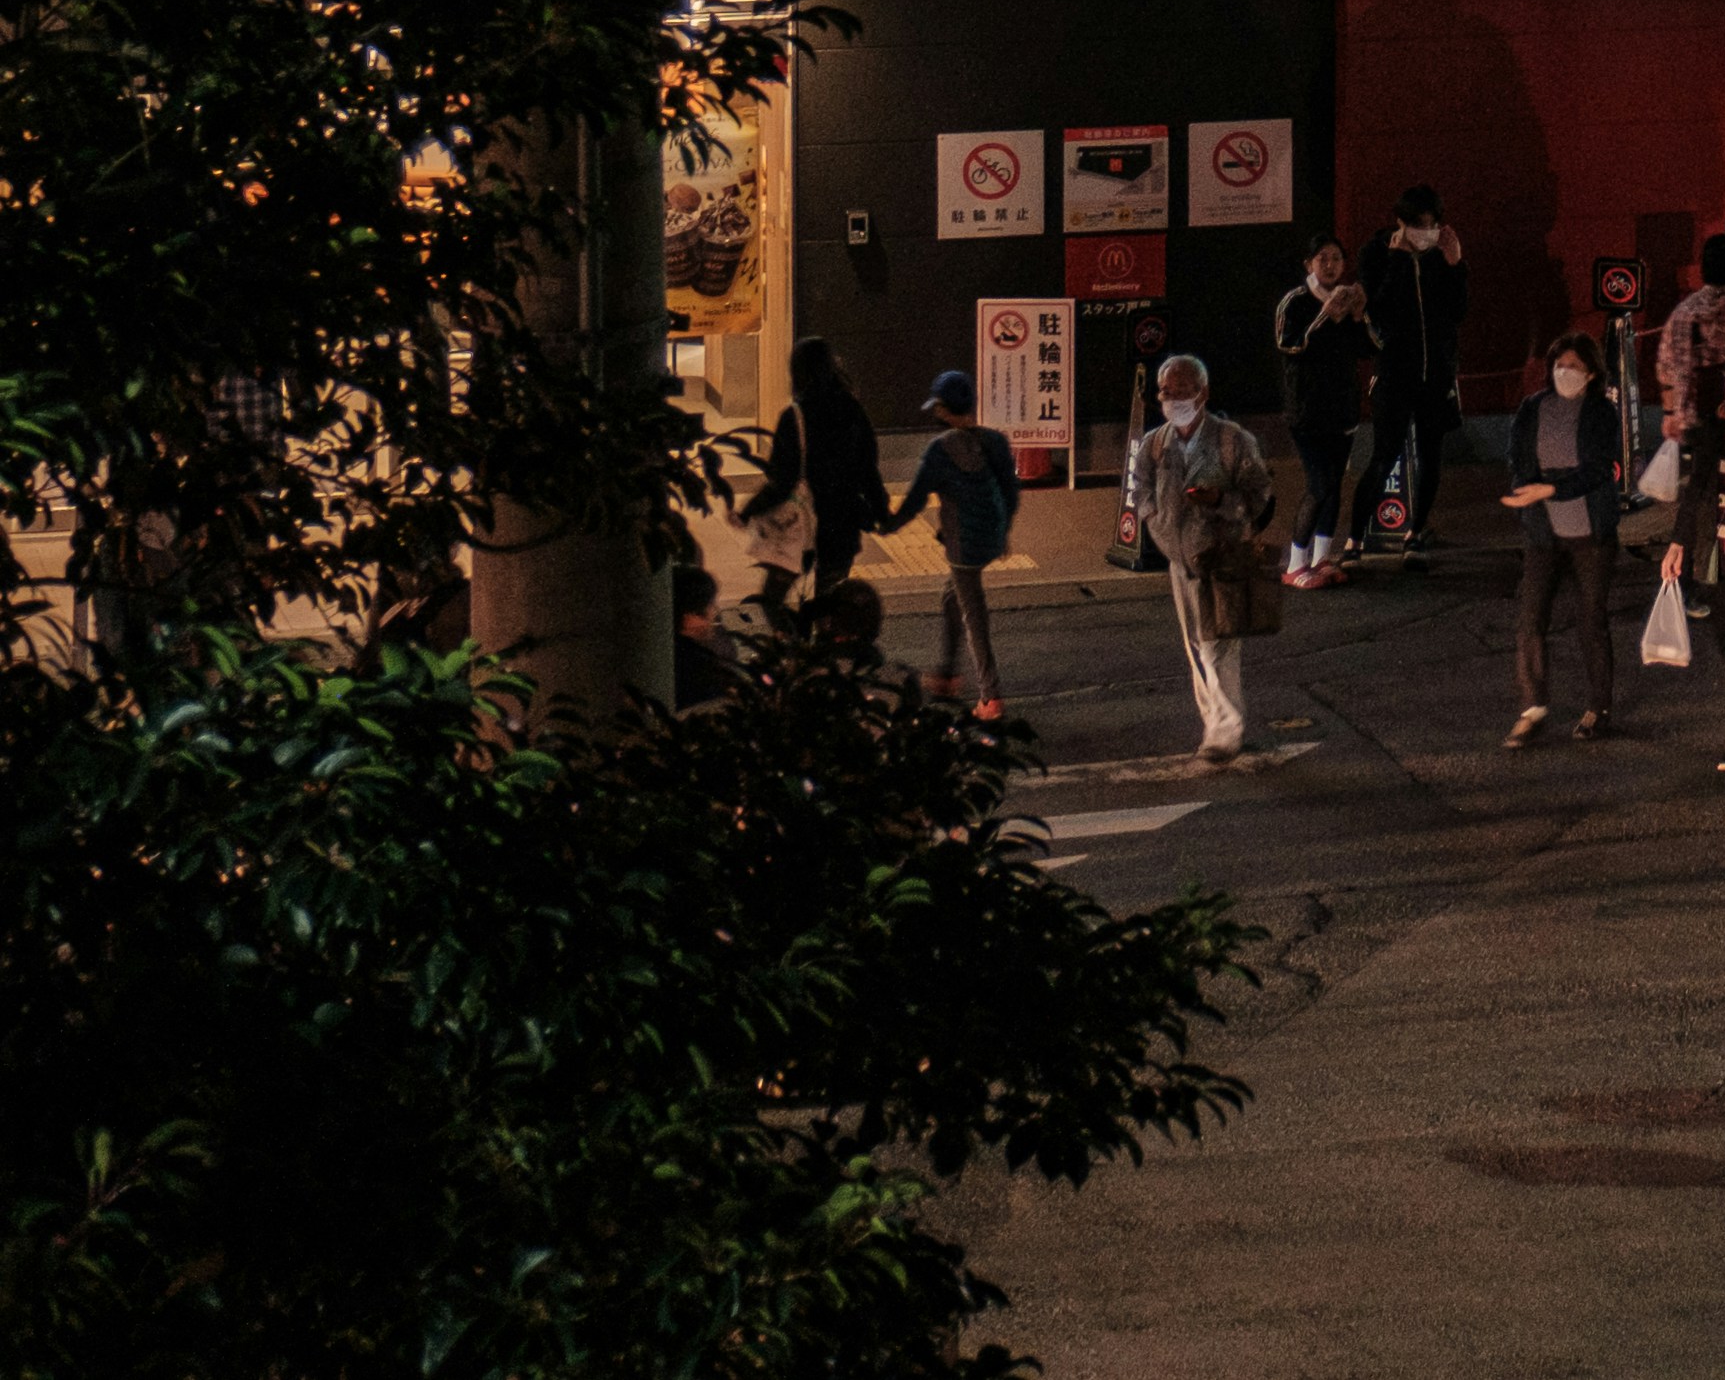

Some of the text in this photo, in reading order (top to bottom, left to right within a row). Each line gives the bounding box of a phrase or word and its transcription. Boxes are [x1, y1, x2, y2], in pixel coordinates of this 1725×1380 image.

[951, 208, 1030, 224] 駐輪禁止
[1037, 312, 1062, 422] 駐輪禁止
[1012, 426, 1067, 440] parking
